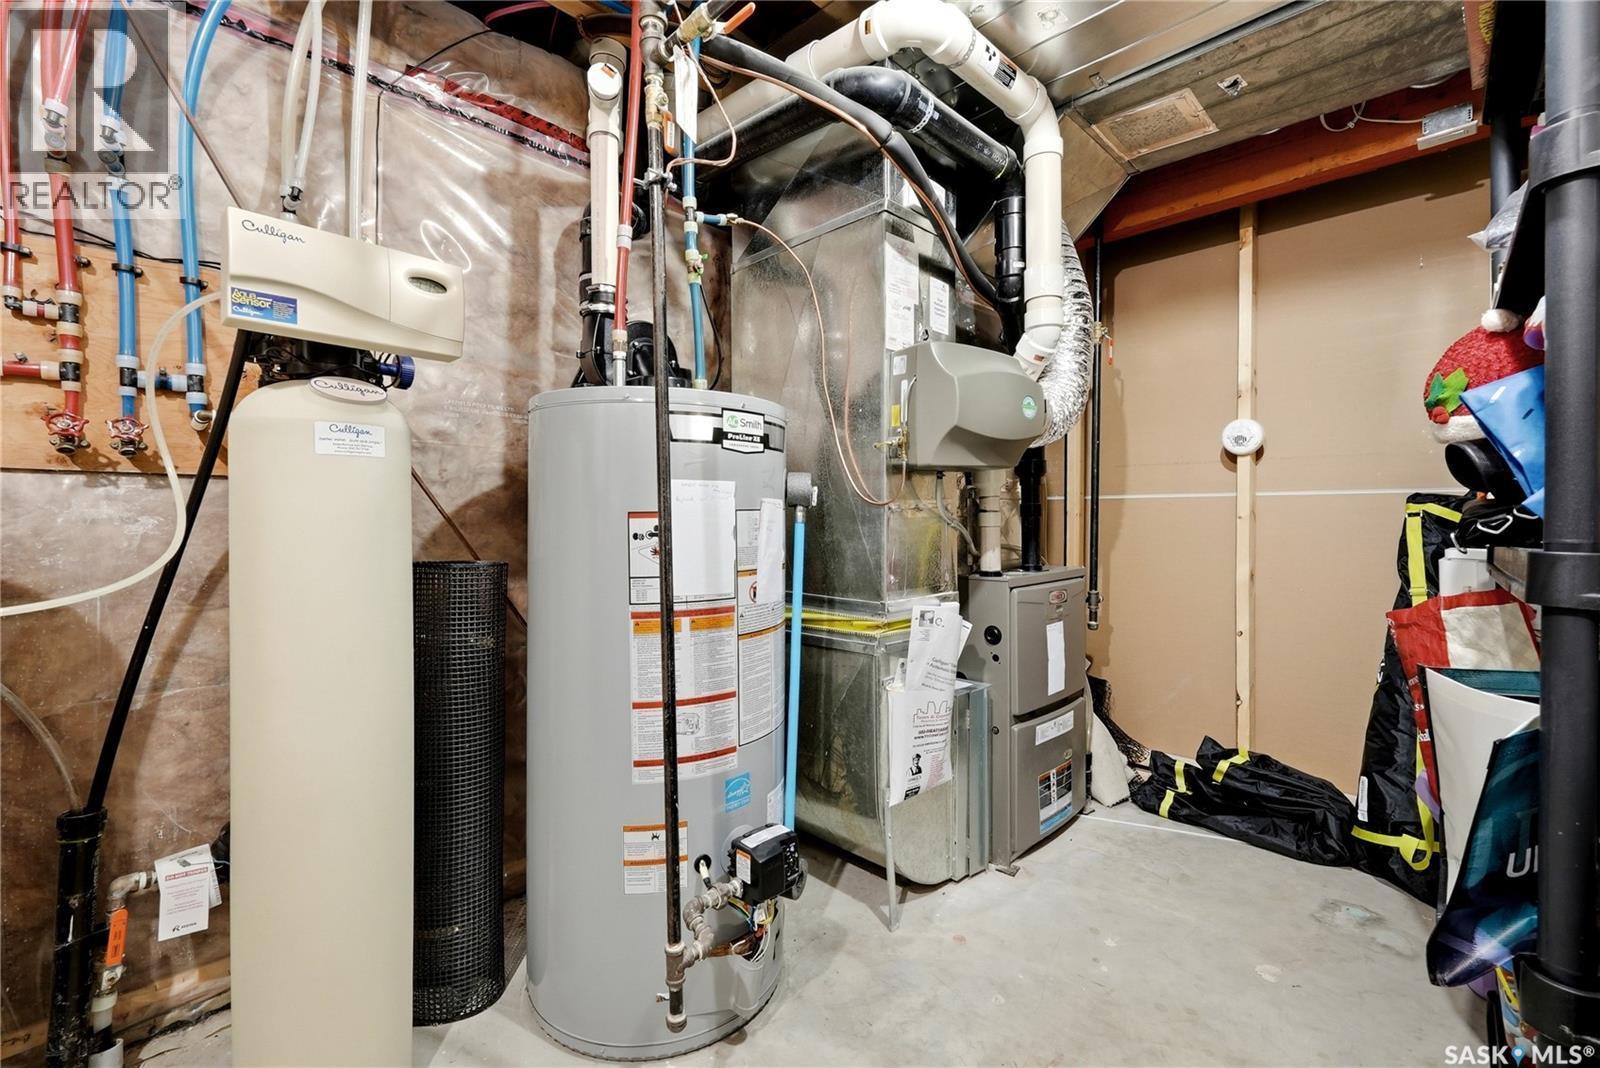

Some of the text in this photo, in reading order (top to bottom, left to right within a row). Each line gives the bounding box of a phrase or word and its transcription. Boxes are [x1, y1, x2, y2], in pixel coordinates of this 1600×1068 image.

[242, 219, 305, 244] Culligan
[231, 294, 272, 308] Sensor
[314, 380, 384, 396] Culligan
[329, 424, 373, 438] Culligan
[740, 418, 762, 431] Smith
